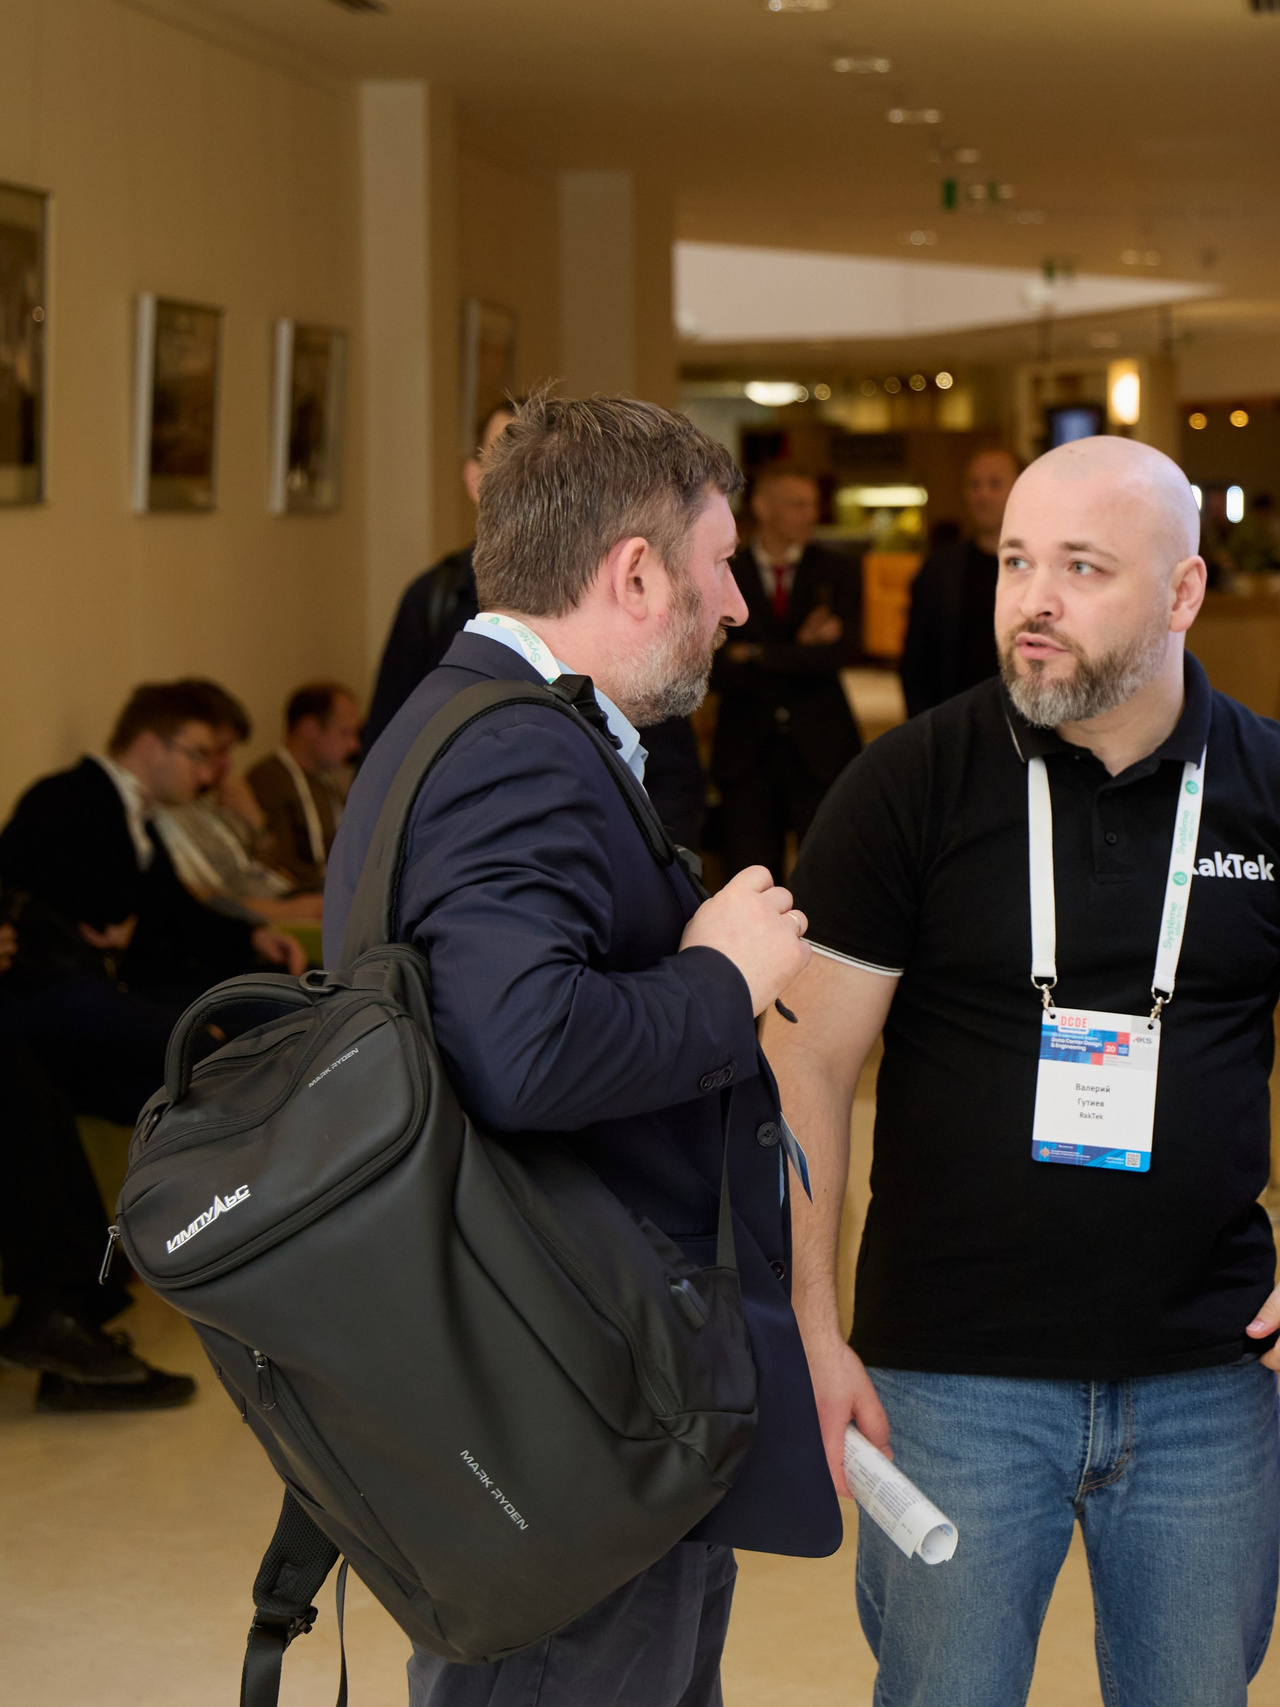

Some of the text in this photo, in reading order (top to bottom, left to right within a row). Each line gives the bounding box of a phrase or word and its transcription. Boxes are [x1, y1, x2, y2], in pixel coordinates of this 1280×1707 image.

[1192, 851, 1275, 882] akTek
[1060, 1016, 1087, 1028] DCDE
[1106, 1044, 1116, 1053] 20
[308, 1048, 359, 1088] MARK RYDEN
[1076, 1084, 1110, 1093] Валерий
[1078, 1098, 1104, 1107] Гутиев
[166, 1184, 251, 1254] ИМПУЛЬС
[460, 1450, 529, 1530] MARK RYDEN
